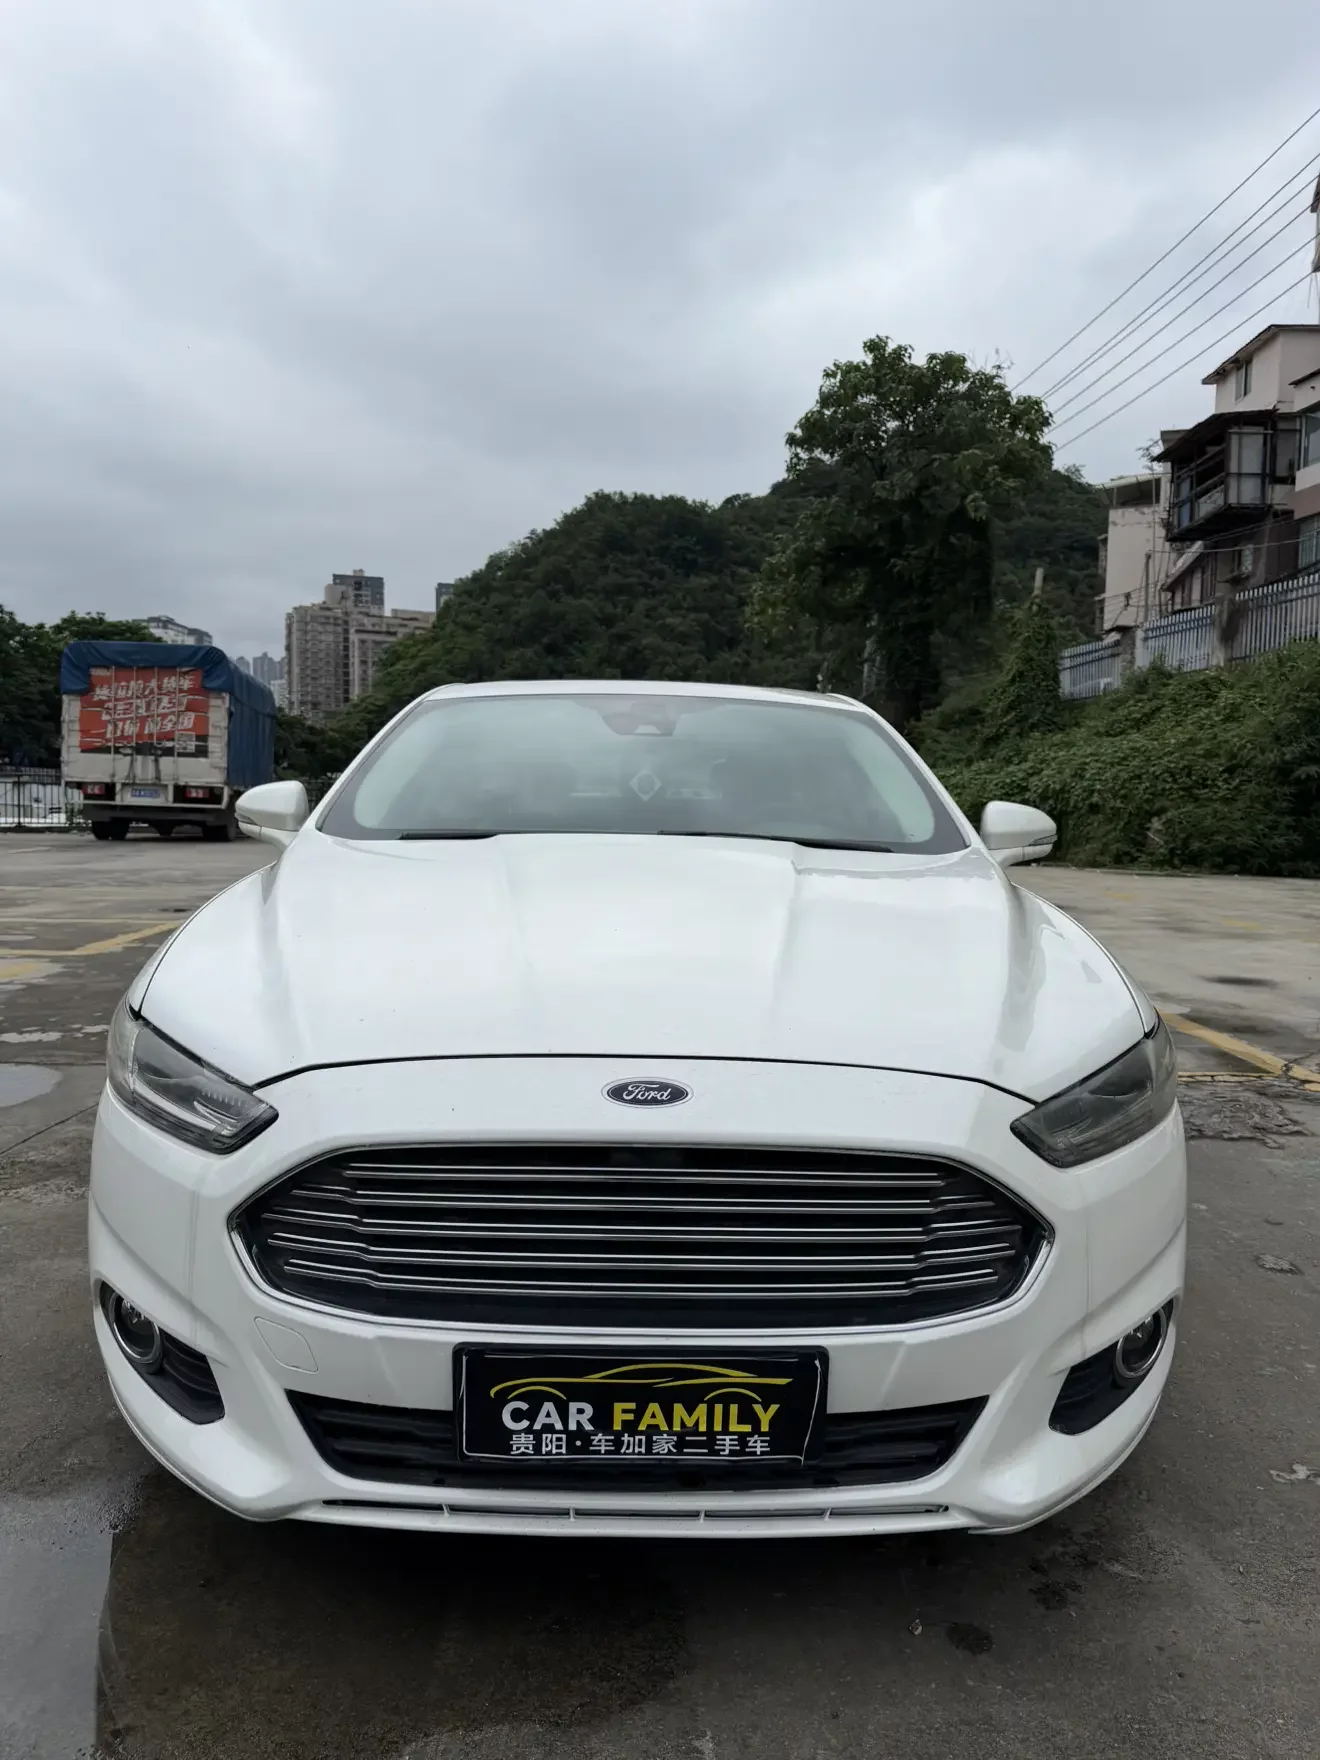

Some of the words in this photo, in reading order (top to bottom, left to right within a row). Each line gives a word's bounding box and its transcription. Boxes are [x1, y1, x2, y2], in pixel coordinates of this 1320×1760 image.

[622, 1083, 672, 1101] Ford
[501, 1400, 594, 1431] CAR
[612, 1403, 781, 1433] FAMILY
